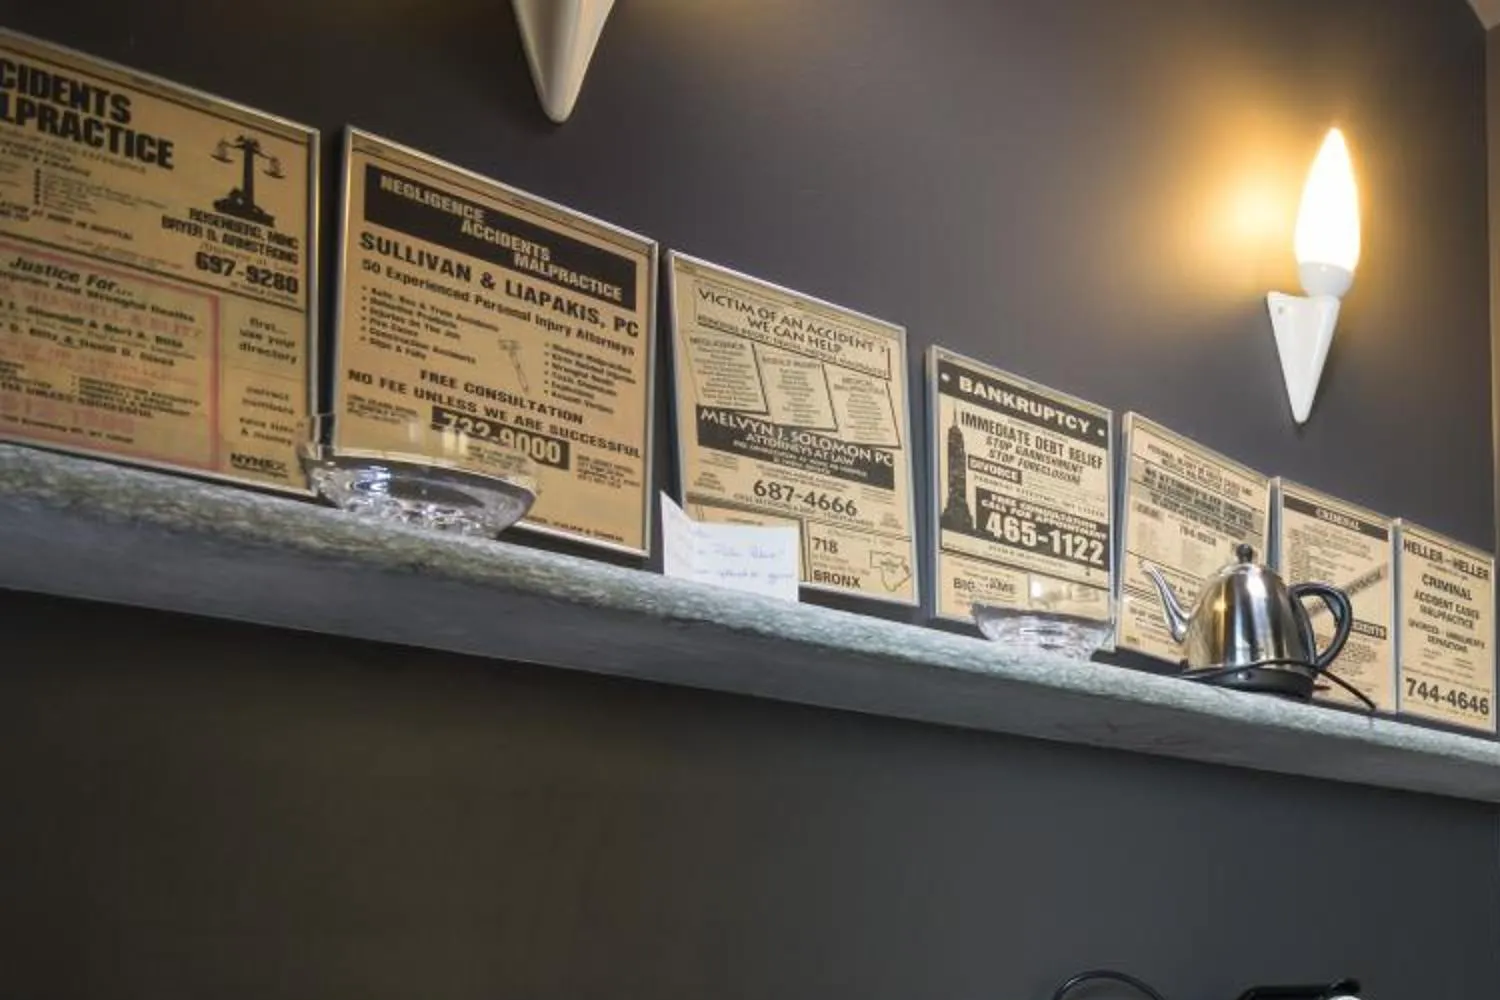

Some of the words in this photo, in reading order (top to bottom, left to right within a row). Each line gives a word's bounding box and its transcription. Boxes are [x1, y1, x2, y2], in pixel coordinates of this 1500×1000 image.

[380, 173, 486, 222] NEGLIGENCE
[460, 221, 551, 262] ACCIDENTS
[8, 254, 79, 284] Justice
[360, 231, 471, 281] SULLIVAN
[479, 271, 495, 290] &
[614, 315, 639, 339] PC
[514, 252, 622, 302] MALPRACTICE
[385, 265, 470, 302] Experienced
[474, 295, 531, 323] Personal
[535, 315, 571, 337] Injury
[698, 287, 755, 316] VICTIM
[781, 315, 803, 330] AN
[808, 323, 874, 352] ACCIDENT
[748, 316, 770, 335] WE
[773, 325, 806, 342] CAN
[348, 368, 371, 385] NO
[379, 376, 406, 394] FEE
[414, 387, 476, 413] UNLESS
[484, 406, 509, 423] WE
[514, 415, 543, 431] ARE
[550, 422, 640, 458] SUCCESSFUL
[420, 369, 457, 389] FREE
[464, 379, 583, 425] CONSULTATION
[959, 375, 1090, 433] BANKRUPTCY
[701, 410, 774, 435] MELVYN
[794, 431, 871, 462] SOLOMON
[875, 451, 893, 465] PC
[961, 411, 1030, 447] IMMEDIATE
[1035, 435, 1063, 456] DEBT
[1068, 446, 1103, 470] RELIEF
[753, 479, 857, 517] 687-4666
[812, 538, 838, 554] 718
[986, 511, 1103, 565] 465-1122
[1403, 537, 1442, 564] HELLER
[1405, 676, 1489, 715] 744-4646
